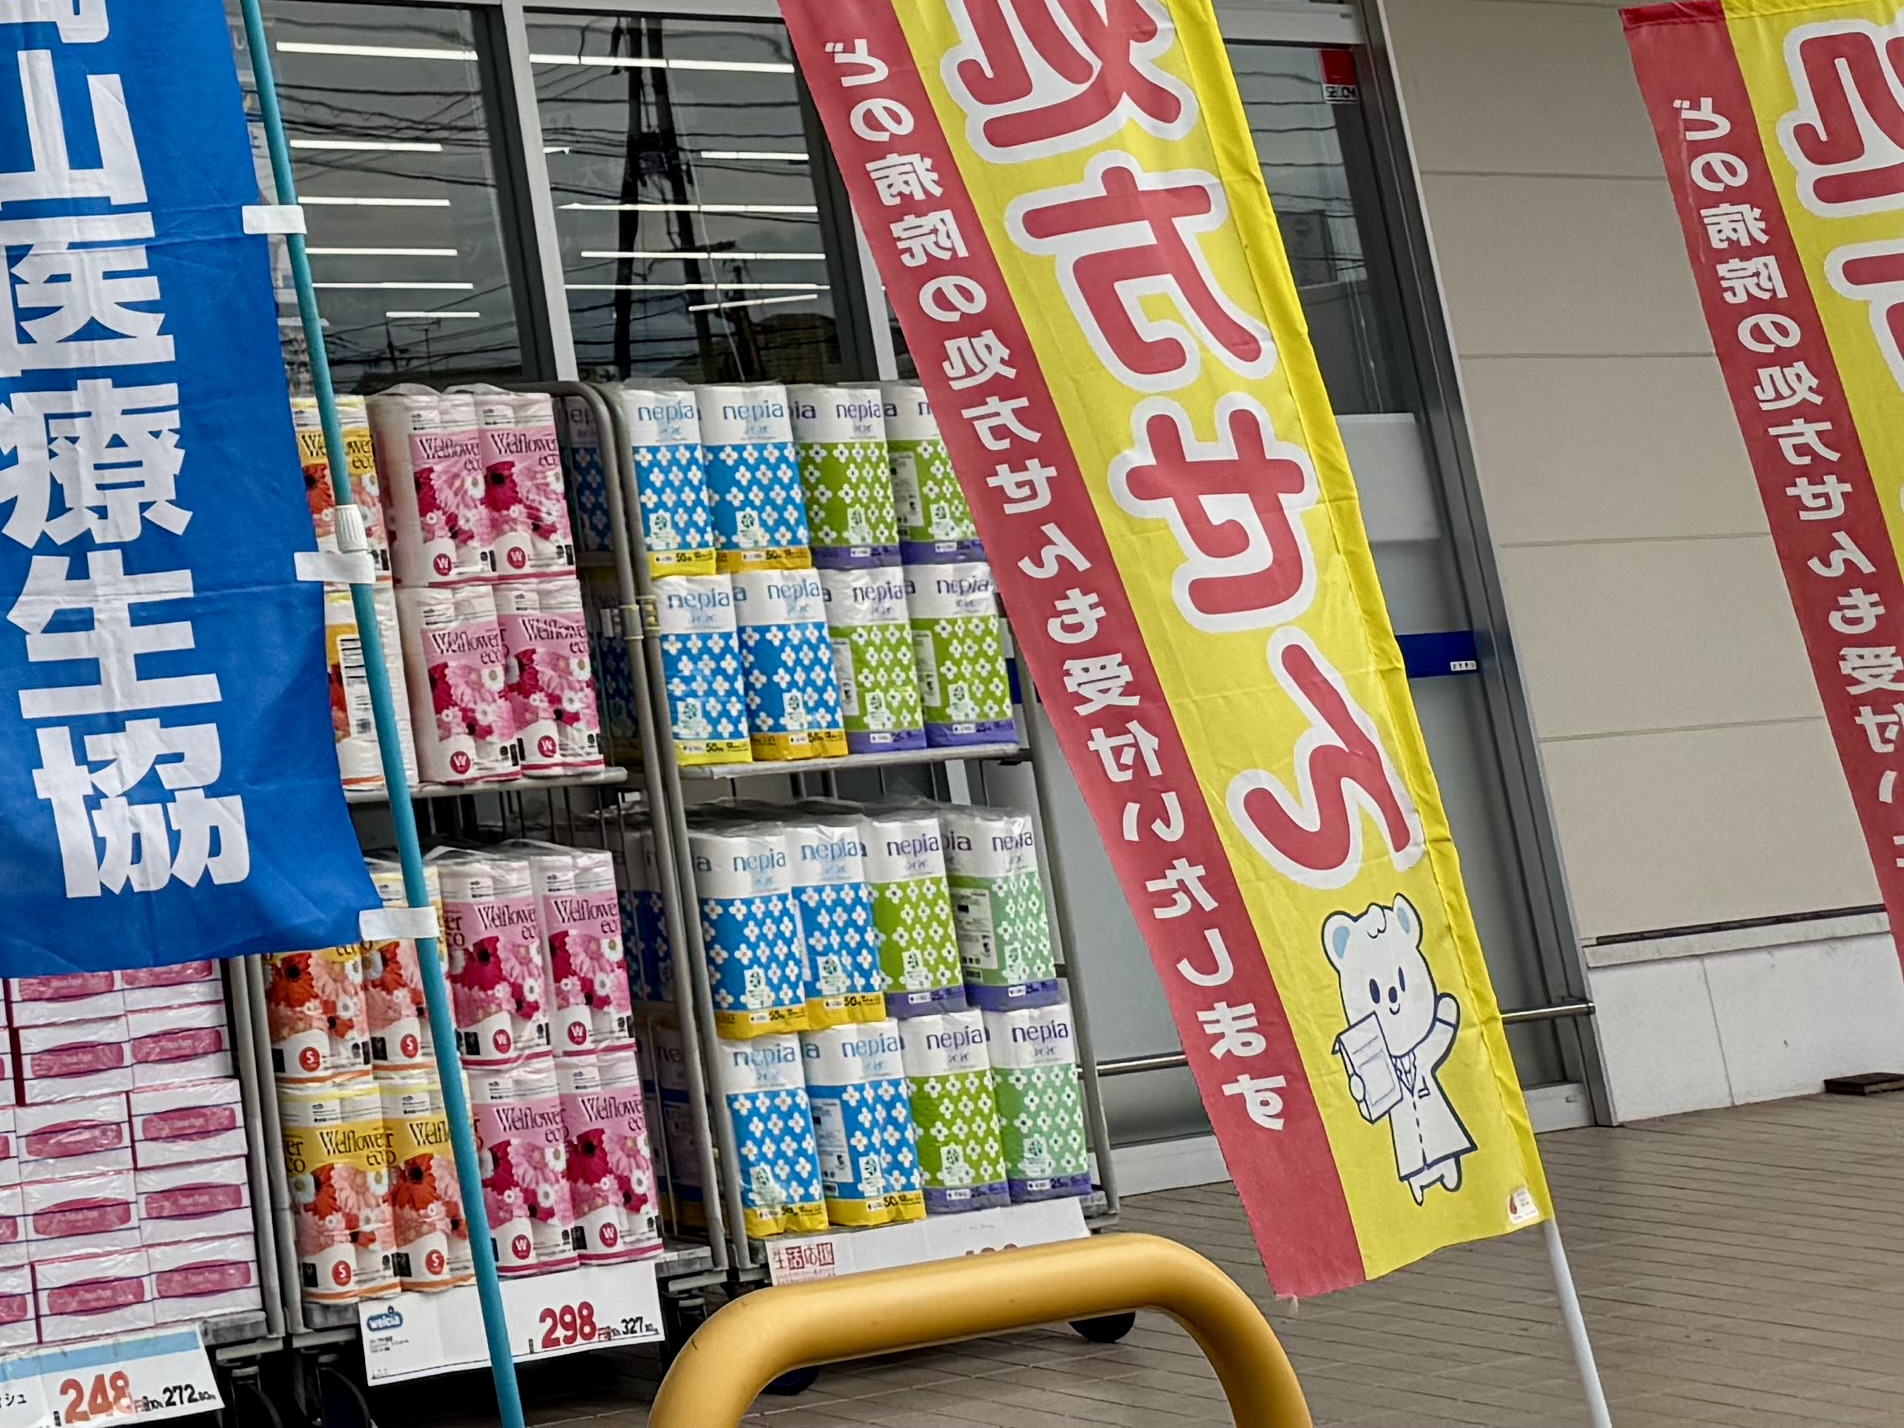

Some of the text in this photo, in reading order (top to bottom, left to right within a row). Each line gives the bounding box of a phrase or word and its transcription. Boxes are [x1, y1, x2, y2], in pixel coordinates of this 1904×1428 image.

[722, 399, 785, 422] nepia
[836, 400, 882, 422] nepia
[732, 846, 786, 878] nepia
[886, 832, 940, 864] nepia
[841, 1030, 900, 1063] nepia
[925, 1024, 984, 1058] nepia
[1011, 1019, 1069, 1051] nepia
[539, 1300, 594, 1350] 298
[59, 1370, 134, 1425] 248
